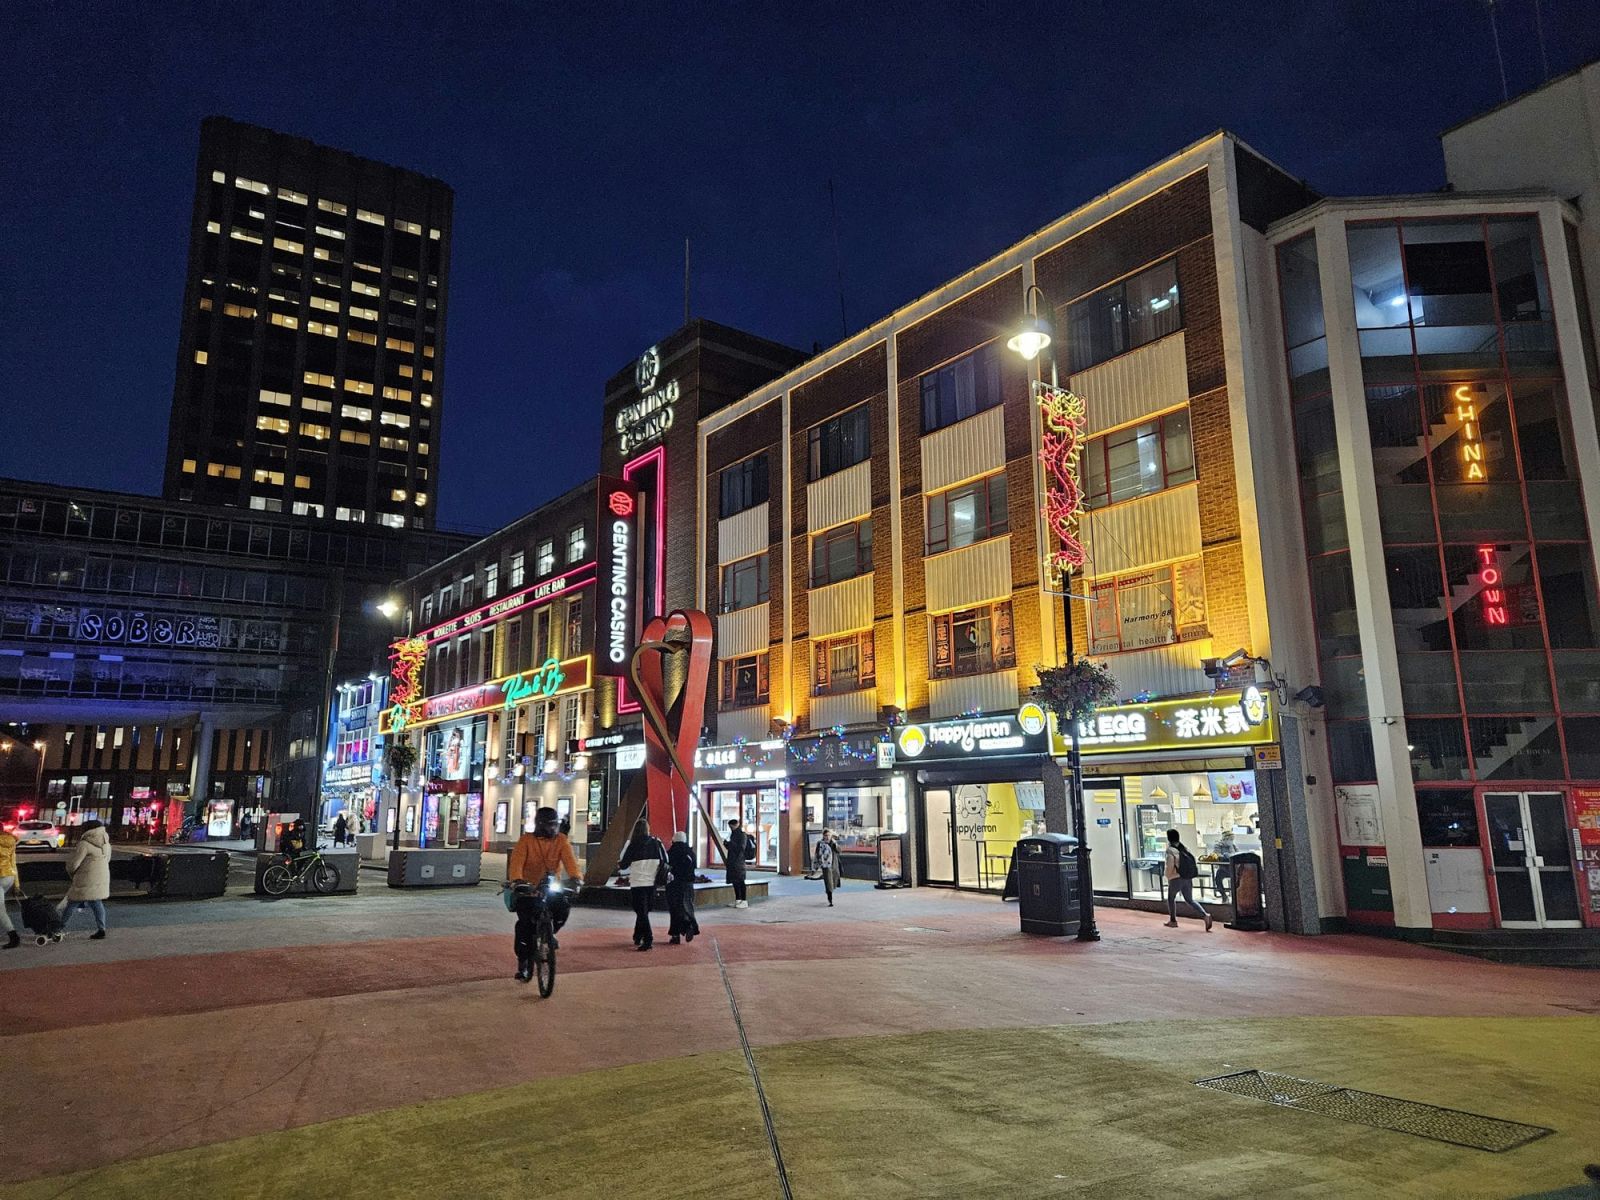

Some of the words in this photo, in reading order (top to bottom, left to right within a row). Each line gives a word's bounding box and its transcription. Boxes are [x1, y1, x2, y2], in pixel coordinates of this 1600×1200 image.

[1455, 386, 1483, 479] CHINA
[612, 520, 629, 596] GENTING
[1479, 548, 1506, 624] TOWN
[433, 621, 458, 639] ROULETTE
[464, 611, 482, 627] SLOTS
[489, 593, 526, 617] RESTAURANT
[534, 584, 551, 600] LATE
[551, 577, 566, 593] BAR
[609, 598, 626, 664] CASINO
[1124, 612, 1159, 625] Harmony
[1138, 634, 1167, 645] health
[1098, 712, 1146, 735] EGG
